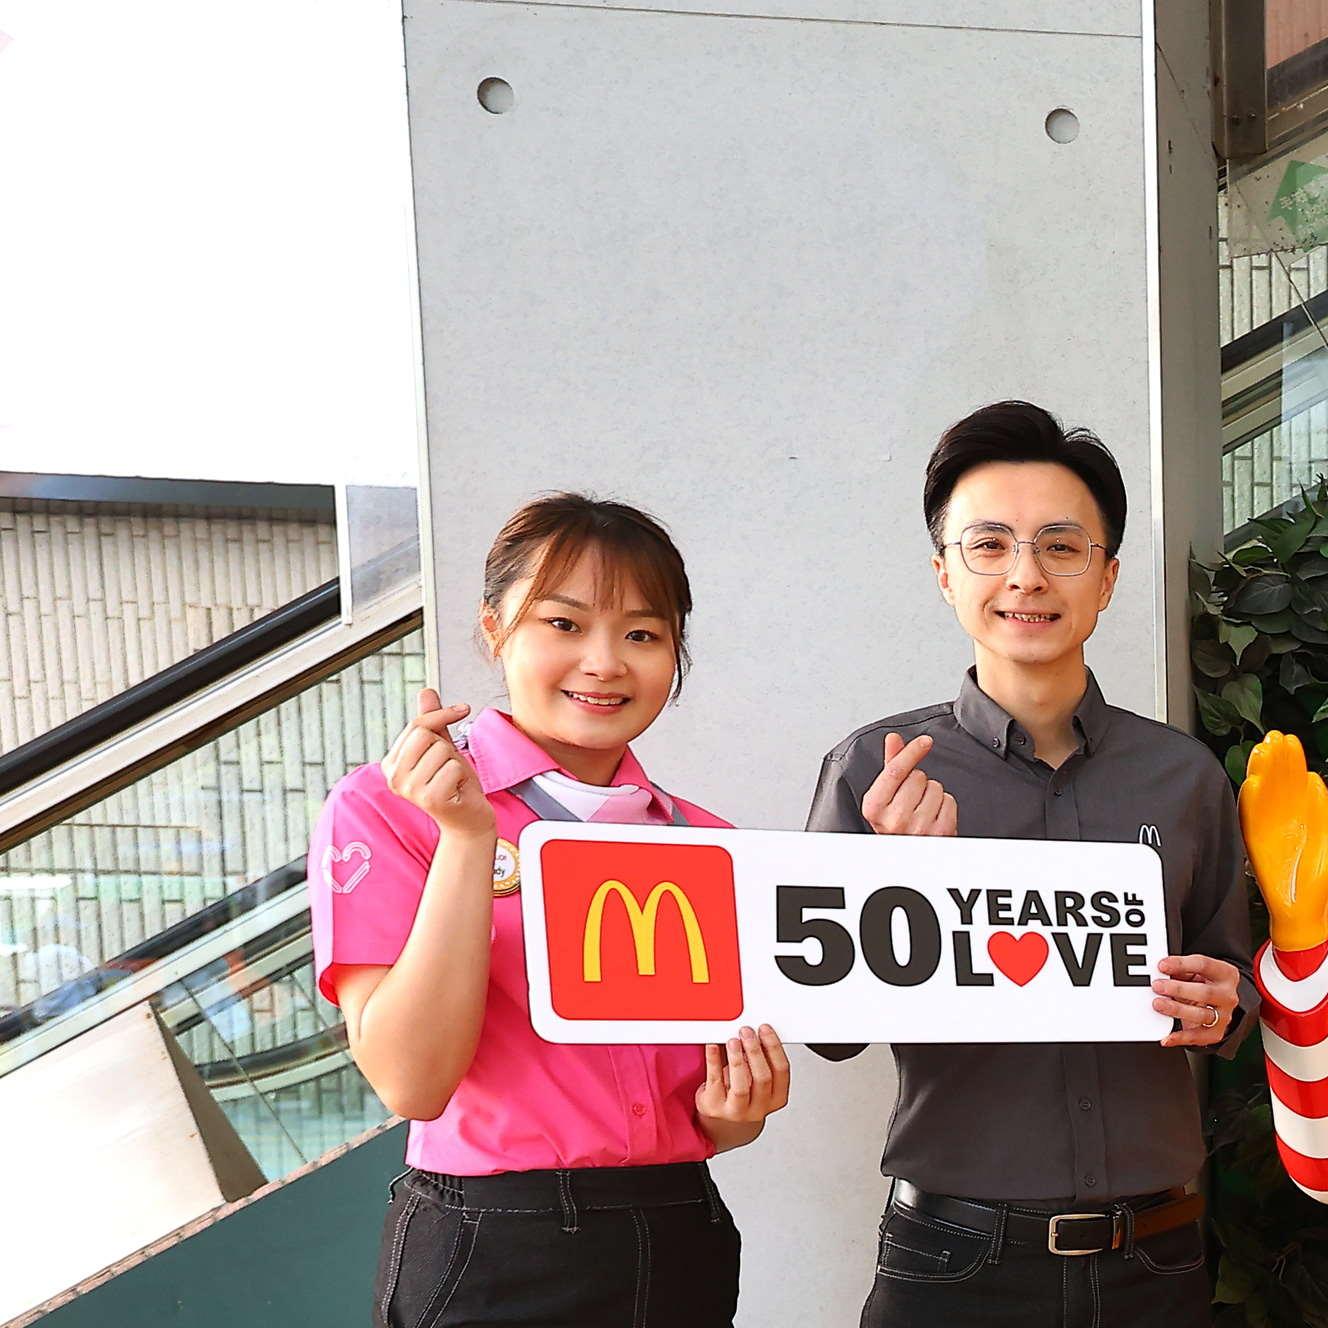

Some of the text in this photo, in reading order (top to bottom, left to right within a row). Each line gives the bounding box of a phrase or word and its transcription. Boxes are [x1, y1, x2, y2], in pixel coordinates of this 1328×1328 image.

[774, 885, 942, 987] 50
[946, 888, 1146, 928] YEARS OF
